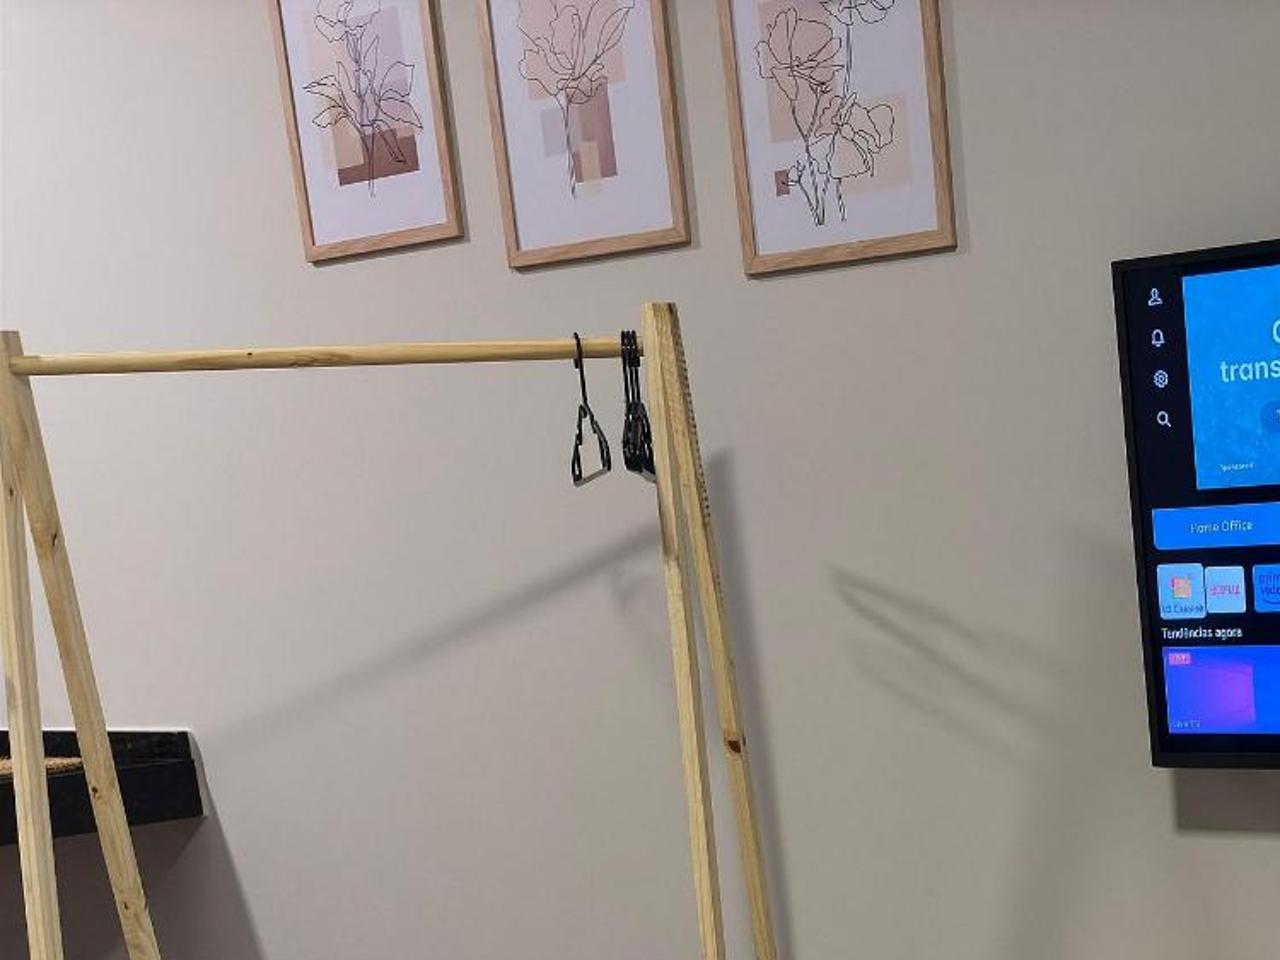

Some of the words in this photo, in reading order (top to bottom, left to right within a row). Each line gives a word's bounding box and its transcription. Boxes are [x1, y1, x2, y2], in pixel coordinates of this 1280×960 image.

[1190, 523, 1219, 534] Home
[1221, 519, 1254, 533] Office
[1214, 629, 1243, 641] agora
